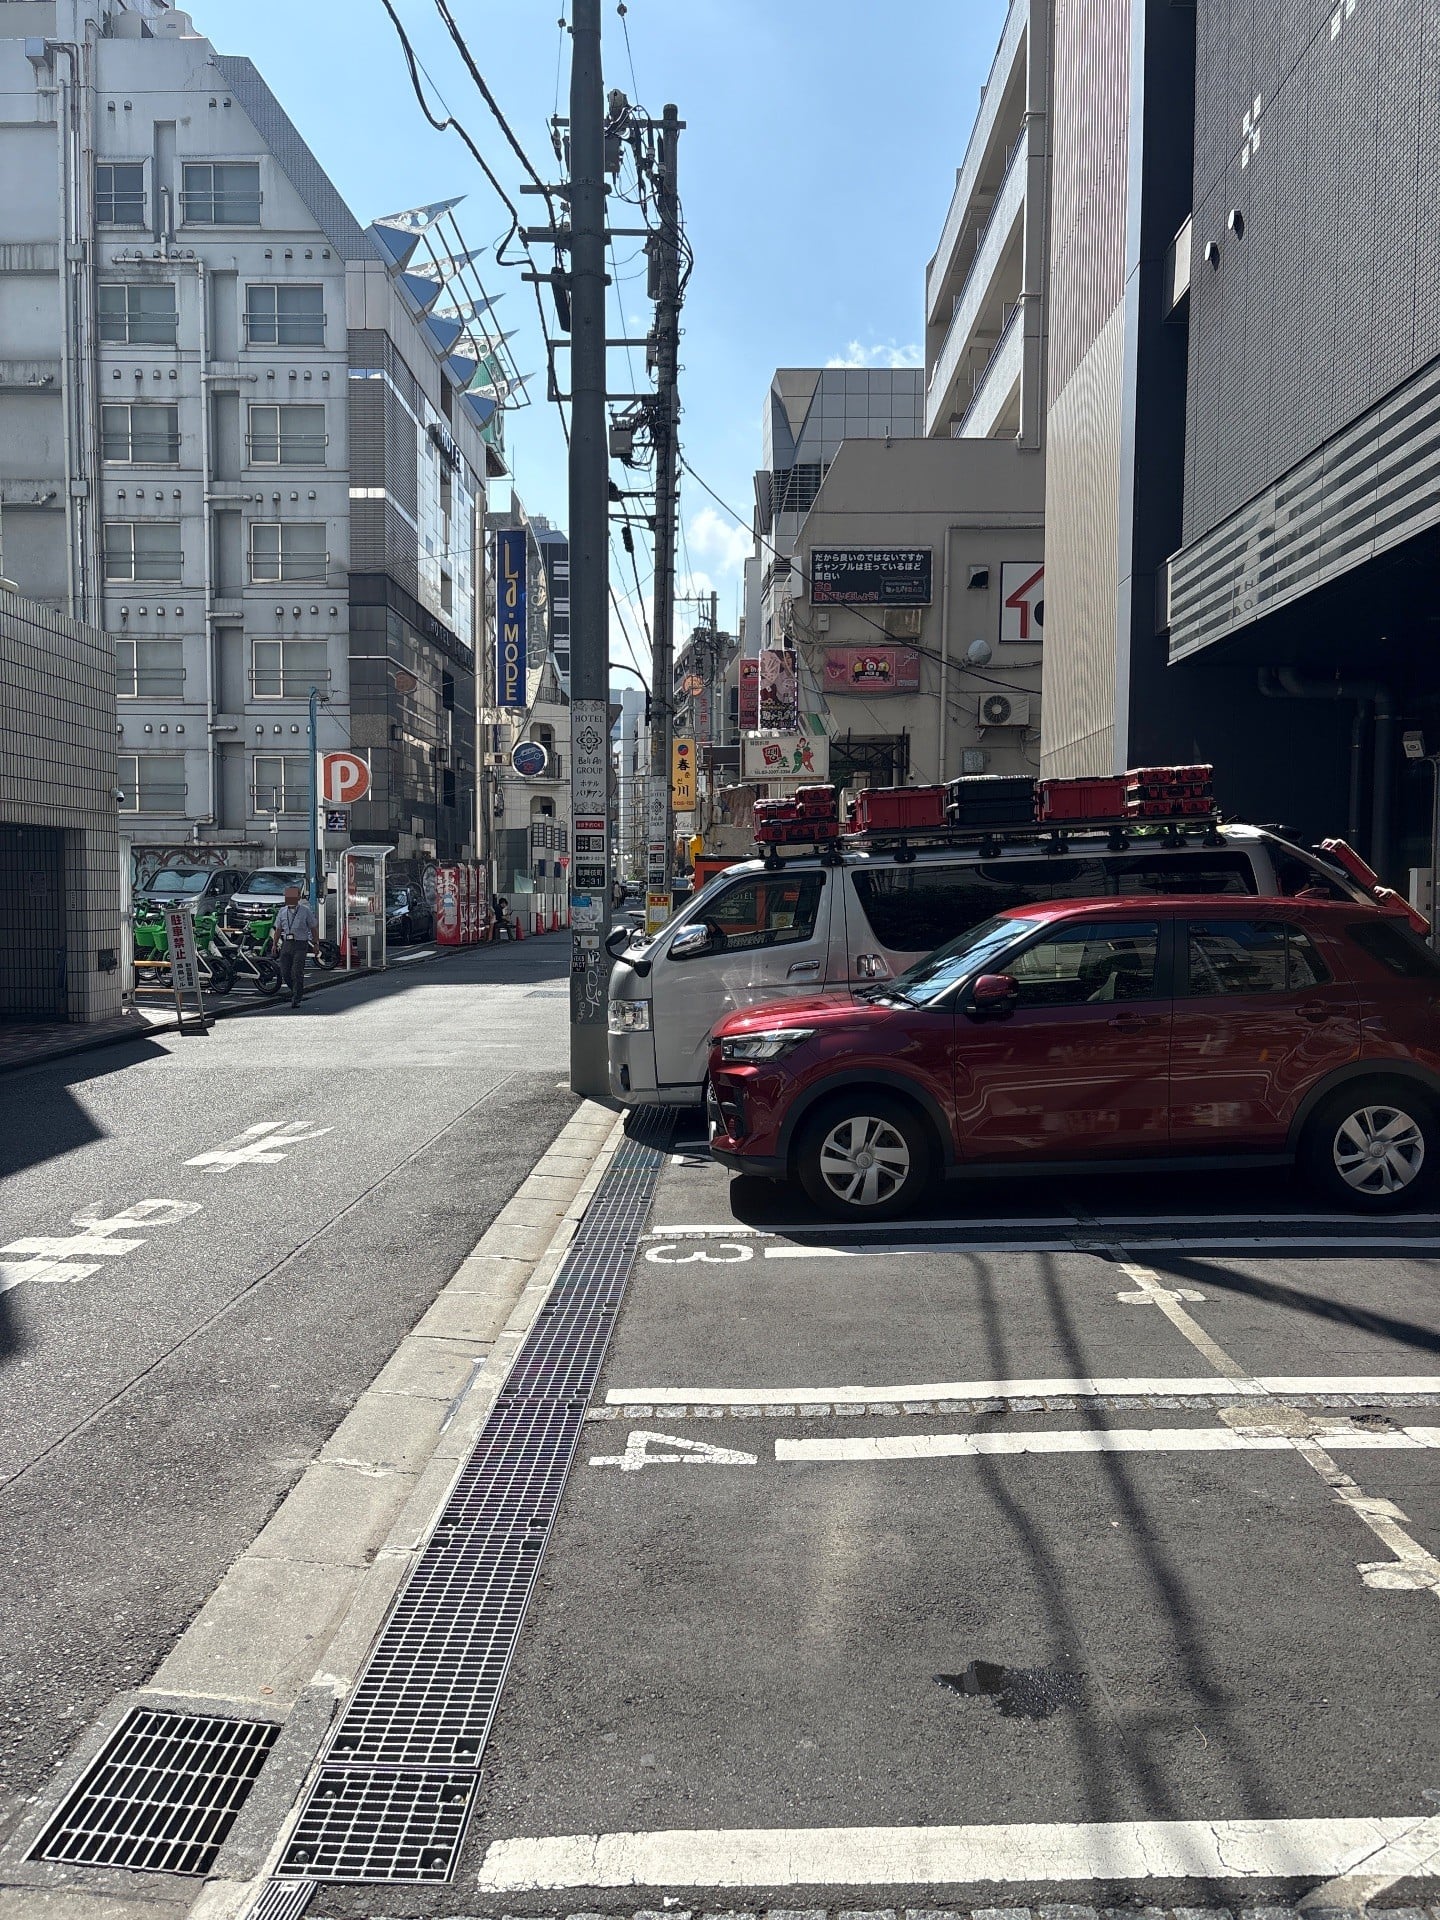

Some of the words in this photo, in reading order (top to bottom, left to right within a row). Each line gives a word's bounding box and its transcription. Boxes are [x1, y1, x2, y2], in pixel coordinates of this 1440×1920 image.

[814, 553, 925, 562] だから良いのではないですか
[814, 562, 921, 571] ギャンブルは狂っているほど
[575, 715, 603, 723] HOTEL
[576, 767, 603, 775] GROUP
[331, 760, 359, 801] P
[580, 780, 600, 788] ホテル
[171, 914, 187, 960] 駐車禁止
[644, 1243, 755, 1264] 3
[588, 1430, 759, 1472] 4
